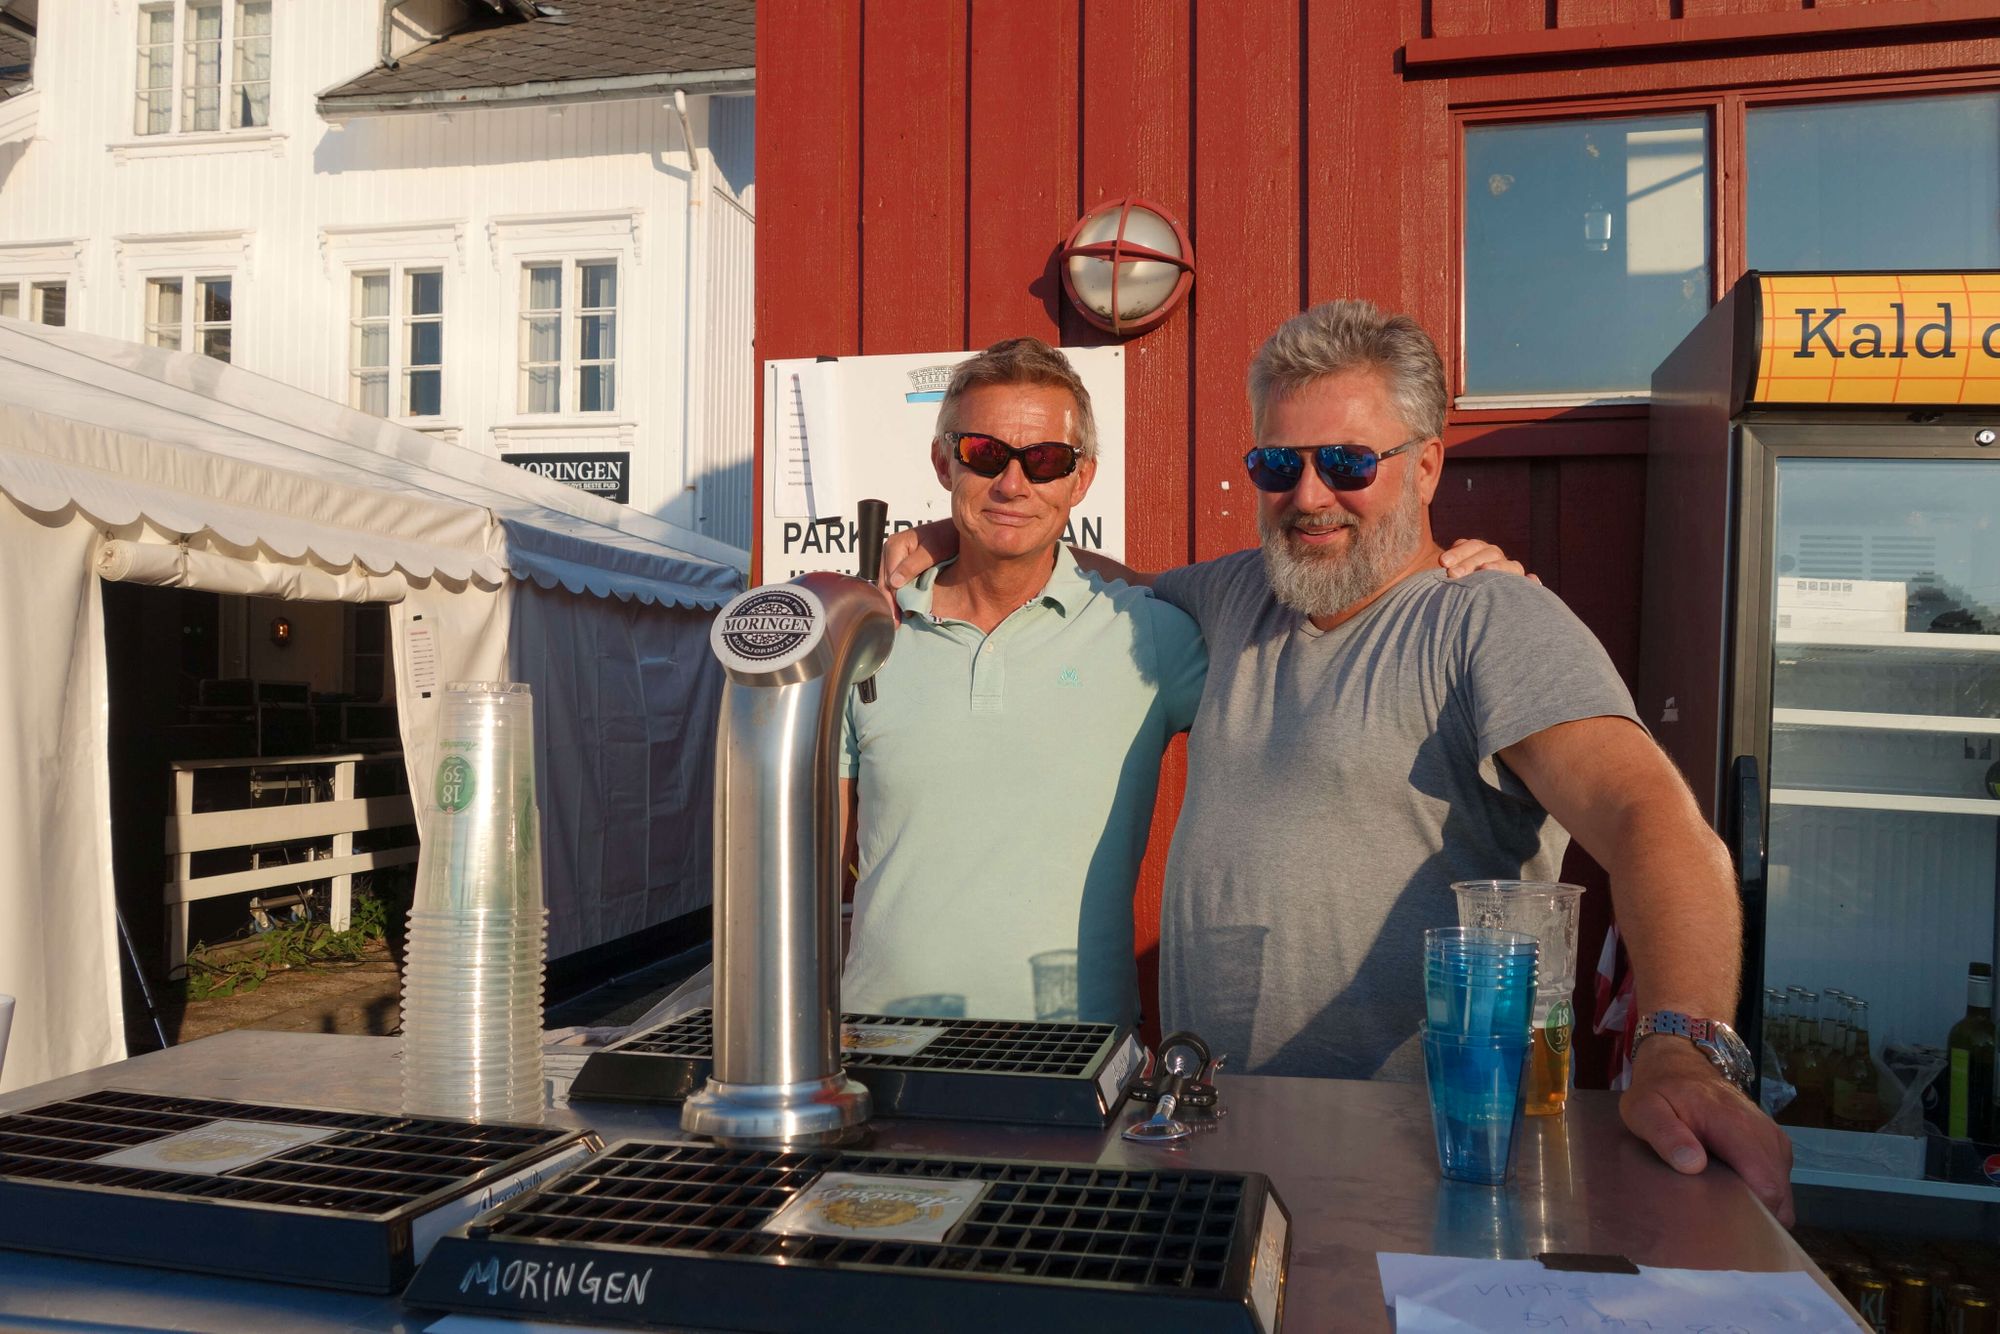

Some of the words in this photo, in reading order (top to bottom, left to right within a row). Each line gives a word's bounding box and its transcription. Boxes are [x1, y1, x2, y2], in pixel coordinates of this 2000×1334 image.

[1793, 303, 1956, 359] Kald
[510, 461, 623, 480] ORINGEN
[722, 617, 815, 632] MORINGEN
[443, 765, 463, 783] 39
[442, 784, 461, 803] 18
[1556, 1008, 1569, 1027] 18
[1555, 1027, 1569, 1045] 39
